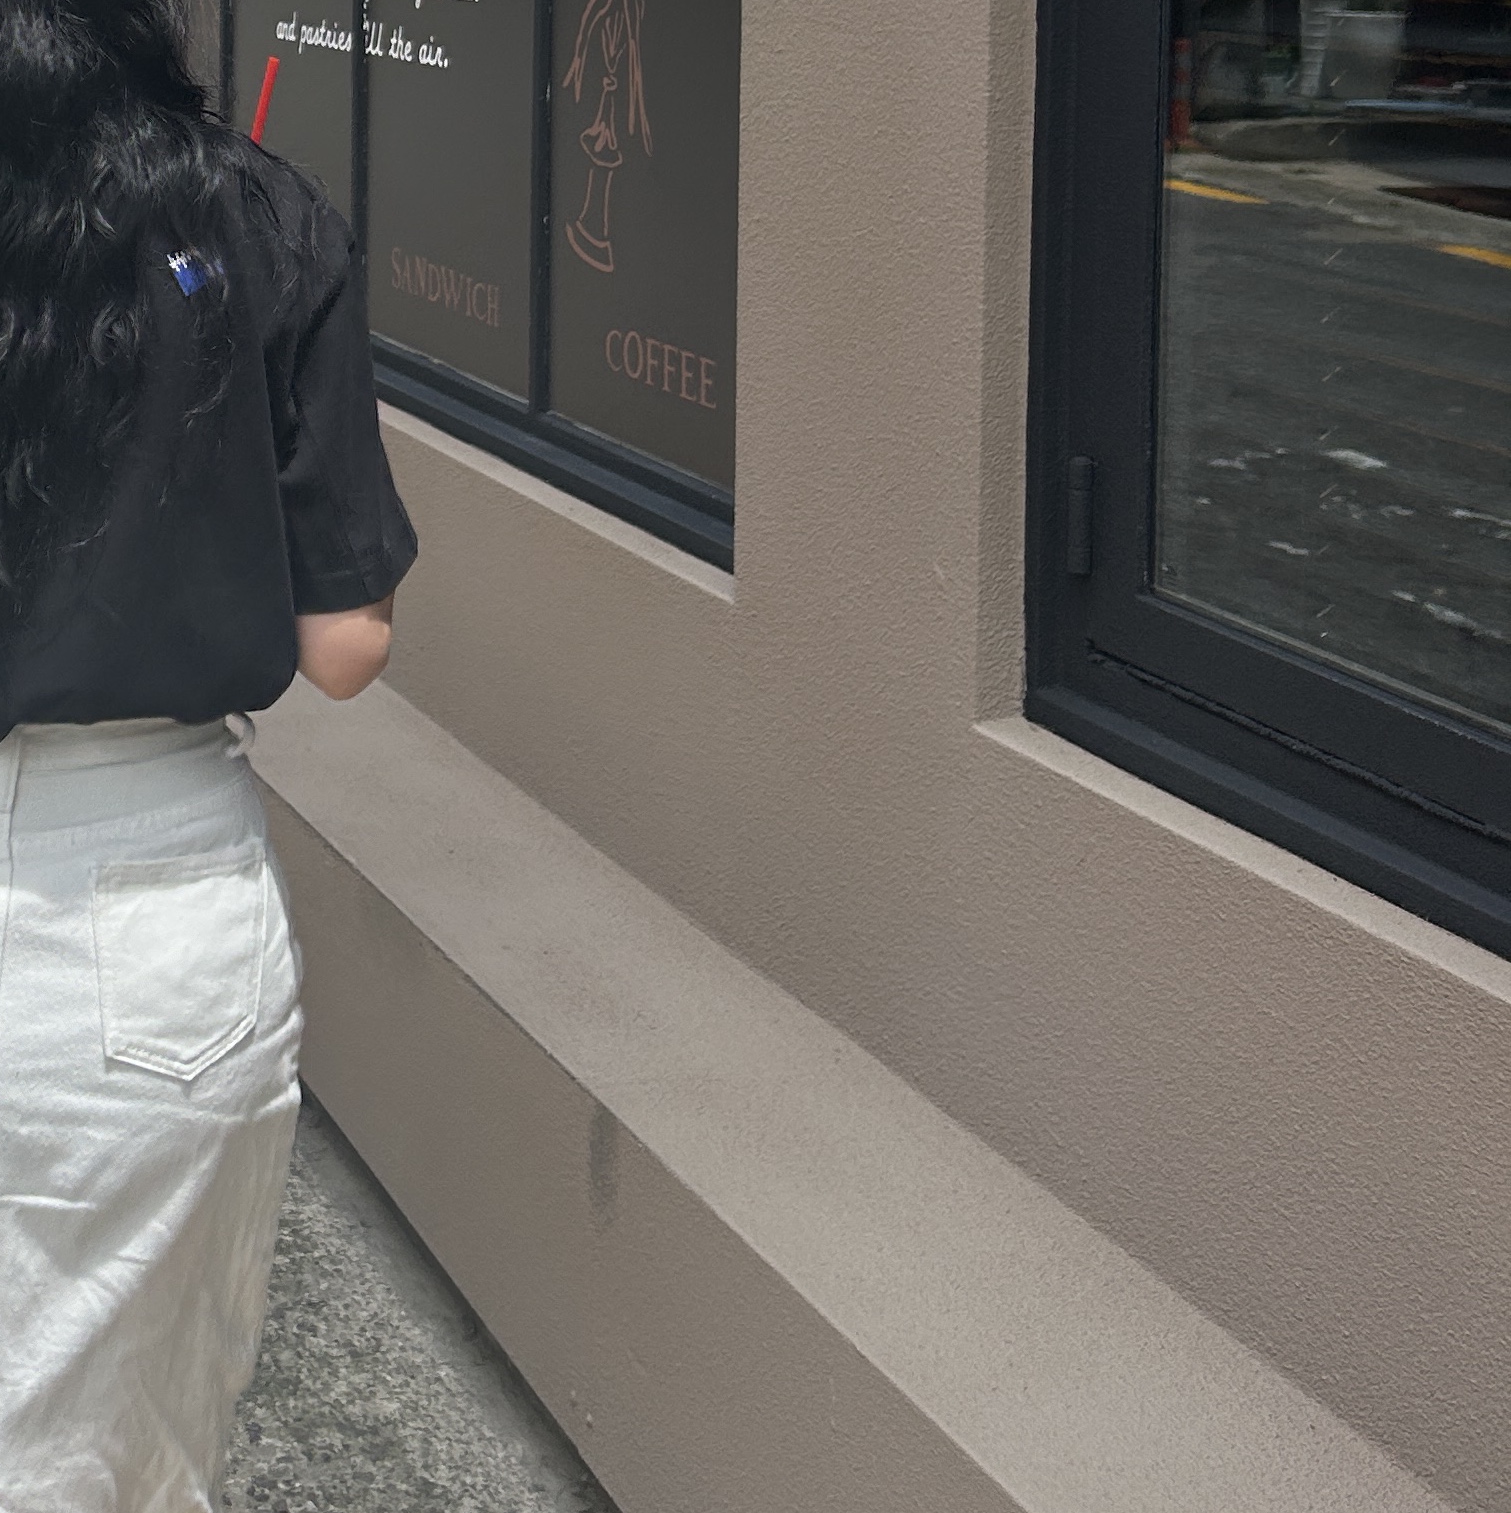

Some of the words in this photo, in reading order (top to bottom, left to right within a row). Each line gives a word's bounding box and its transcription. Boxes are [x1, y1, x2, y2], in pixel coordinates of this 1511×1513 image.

[276, 11, 296, 41] and
[299, 19, 352, 54] pastries
[388, 25, 412, 62] the
[418, 36, 449, 68] air.
[391, 247, 499, 327] SANDWICH
[606, 330, 717, 409] COFFEE
